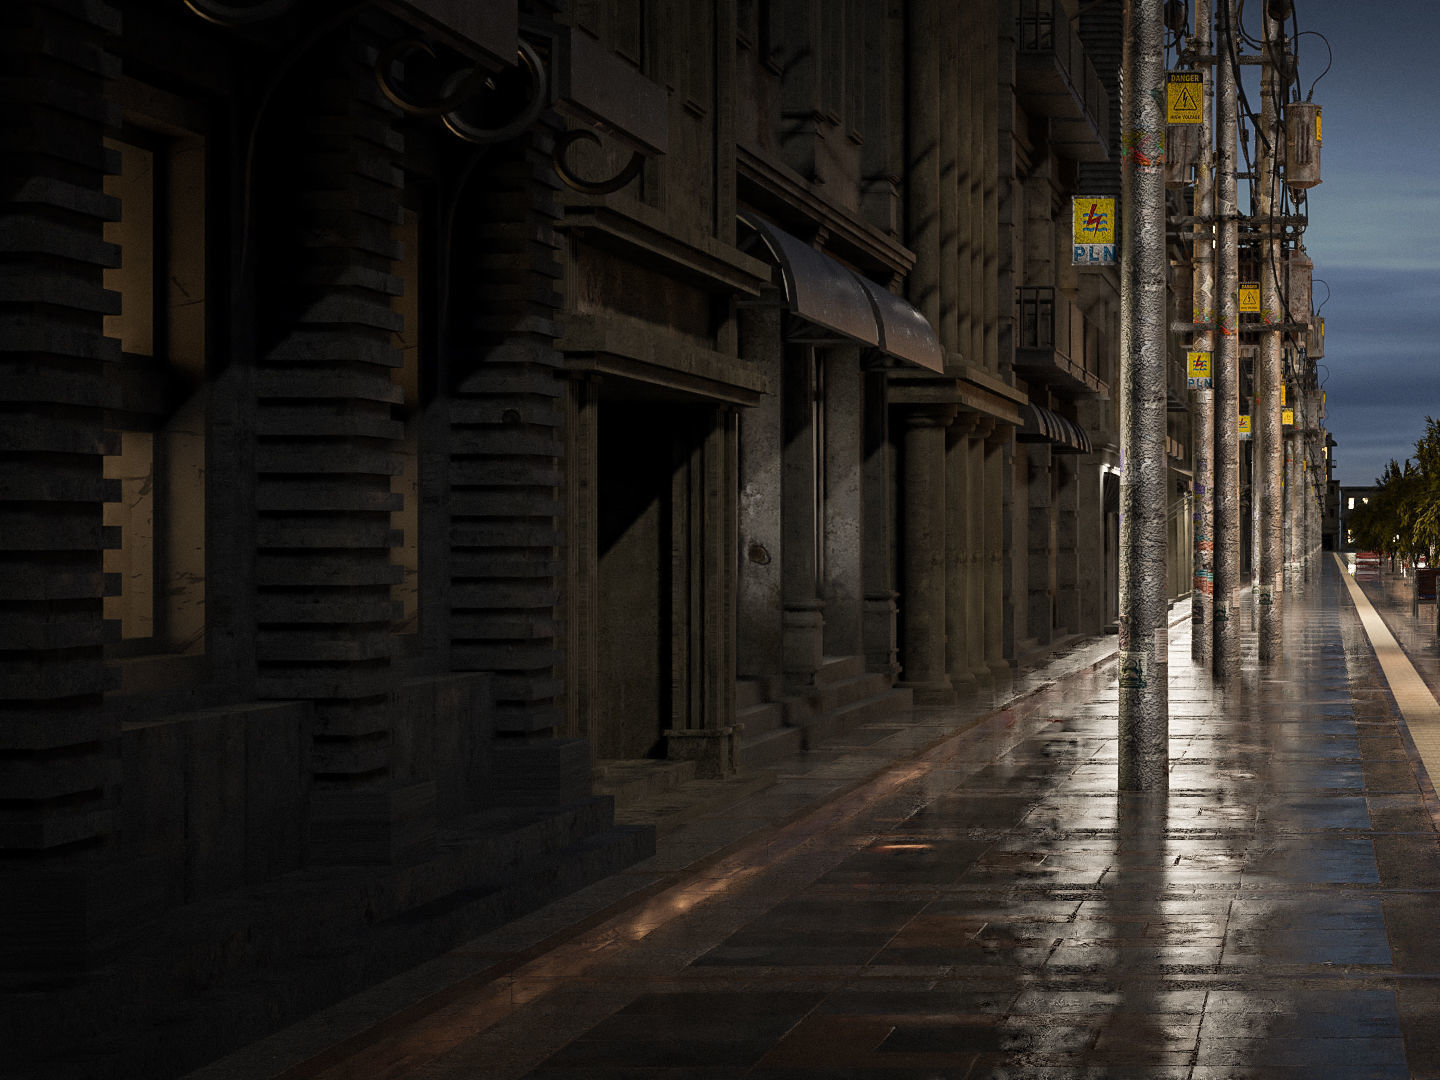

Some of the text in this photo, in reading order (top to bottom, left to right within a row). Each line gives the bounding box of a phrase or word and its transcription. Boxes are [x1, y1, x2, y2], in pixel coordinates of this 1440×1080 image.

[1170, 74, 1200, 82] DANGER
[1073, 246, 1116, 261] PLN
[1188, 378, 1213, 388] PLN
